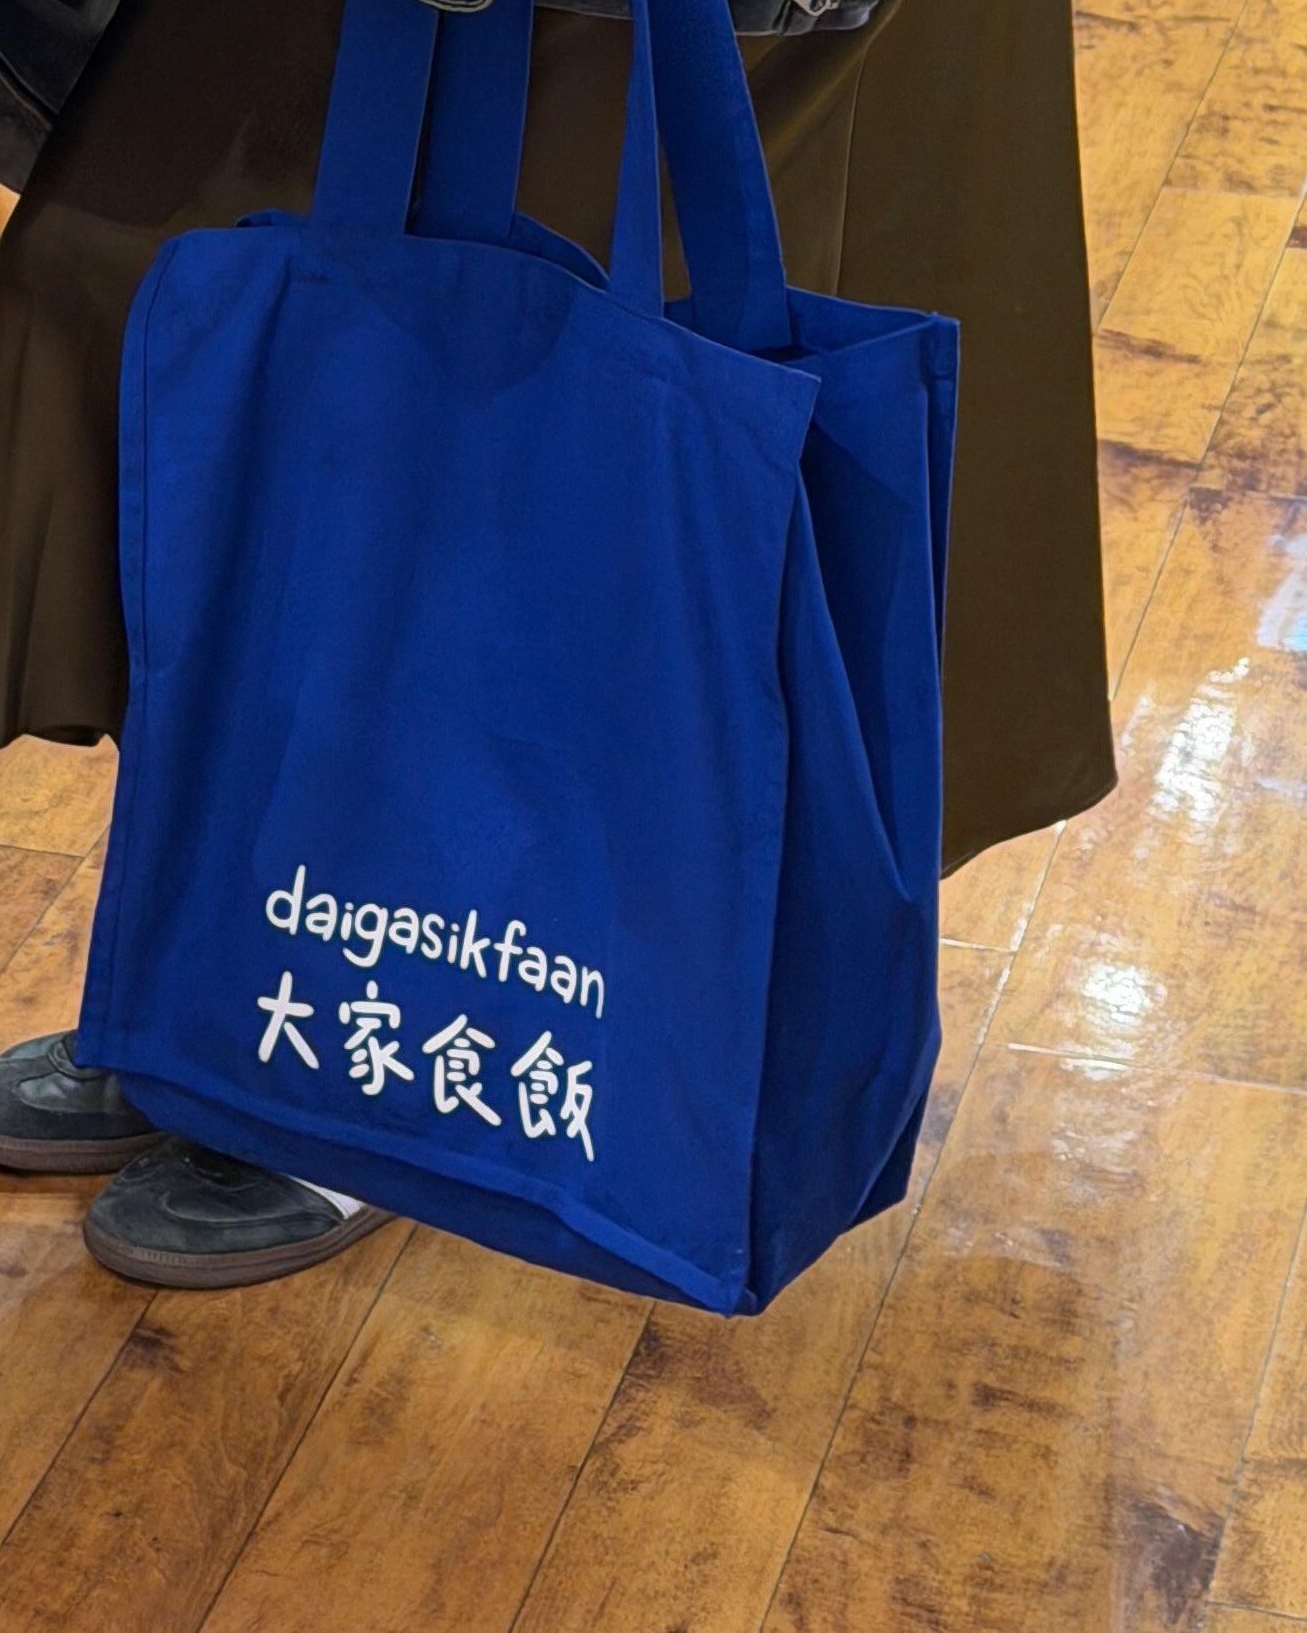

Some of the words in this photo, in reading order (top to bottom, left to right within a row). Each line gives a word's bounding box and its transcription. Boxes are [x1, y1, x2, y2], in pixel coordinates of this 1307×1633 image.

[265, 864, 605, 1019] daigasikfaan
[257, 970, 595, 1162] 大家食飯
